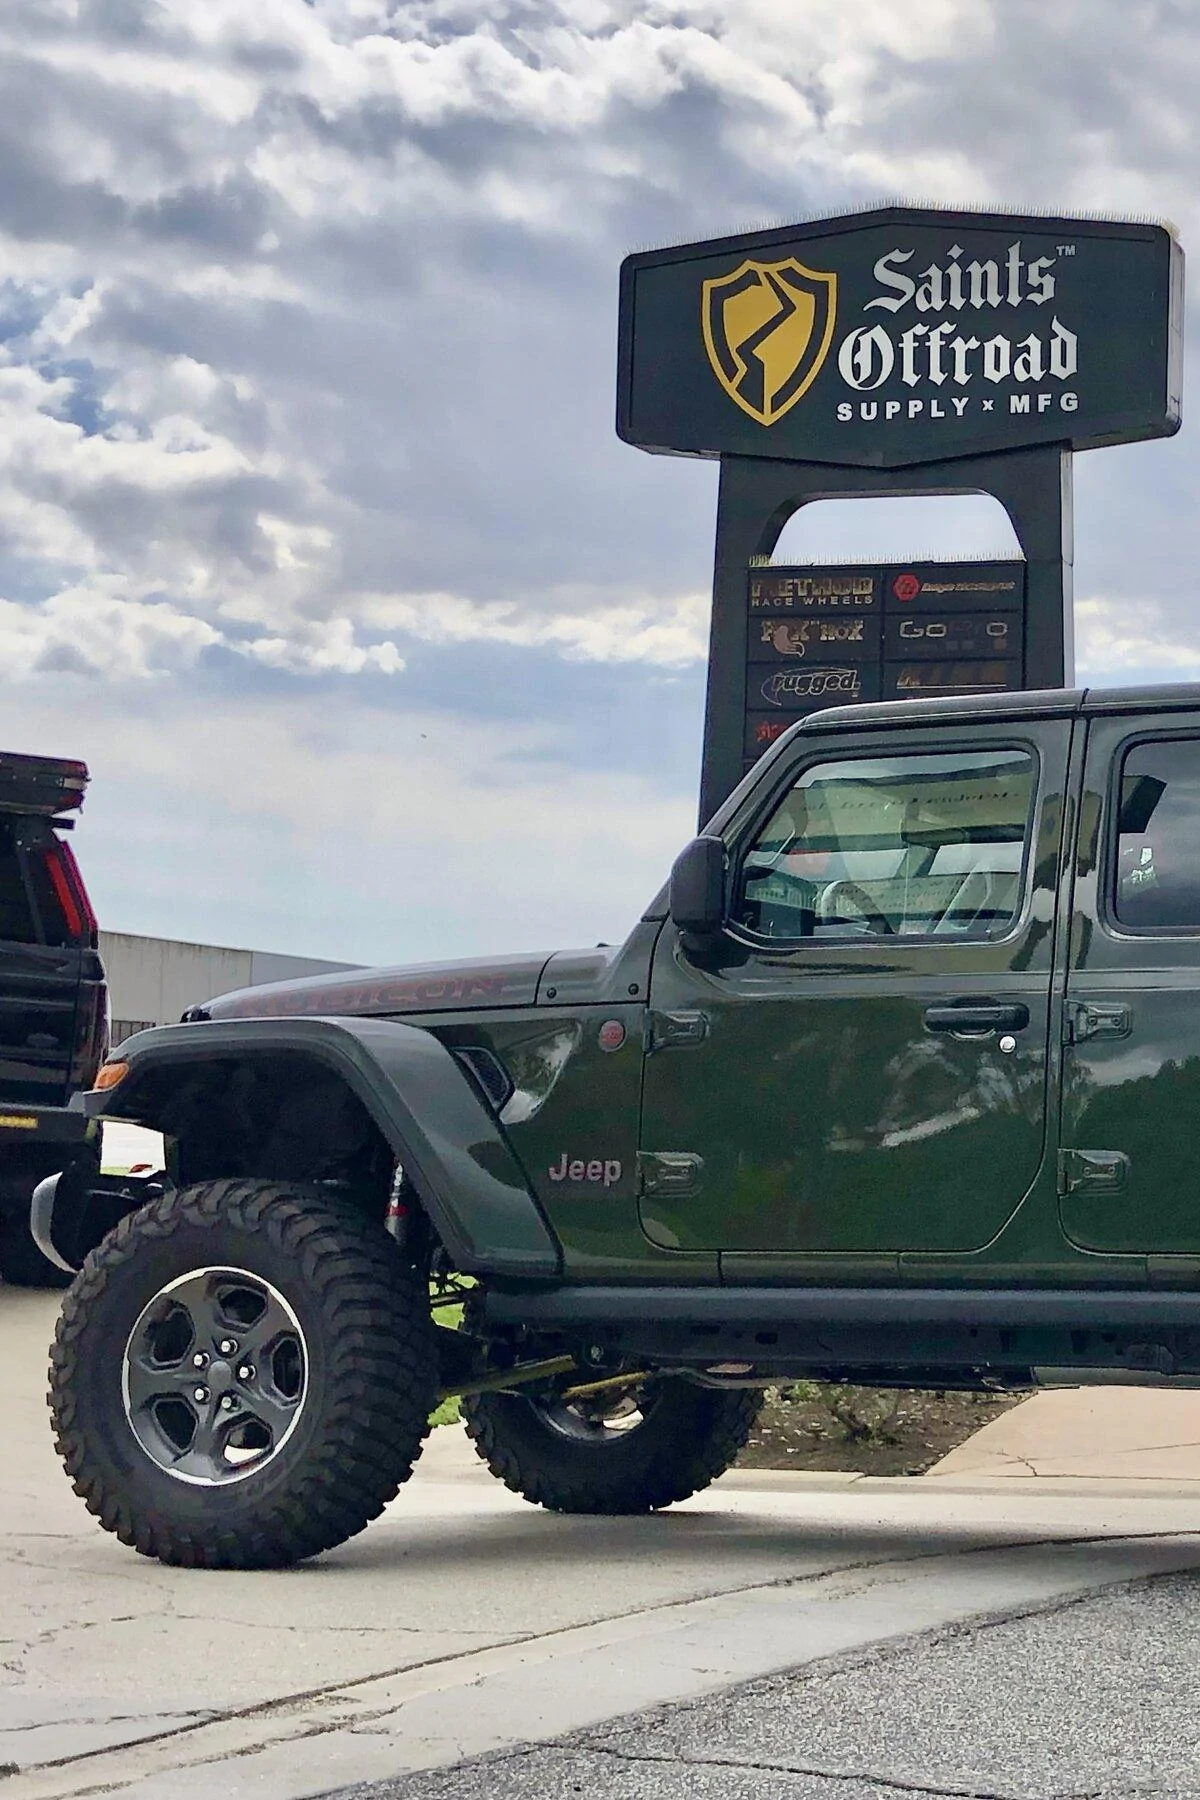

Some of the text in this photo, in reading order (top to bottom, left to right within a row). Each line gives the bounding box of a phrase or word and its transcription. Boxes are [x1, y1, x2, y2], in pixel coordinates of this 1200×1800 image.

[862, 240, 1057, 314] Saints
[837, 316, 1078, 392] Offroad
[836, 397, 967, 422] SUPPLY
[1009, 392, 1079, 414] MFG
[804, 595, 873, 605] WHEELS
[549, 1153, 622, 1187] Jeep
